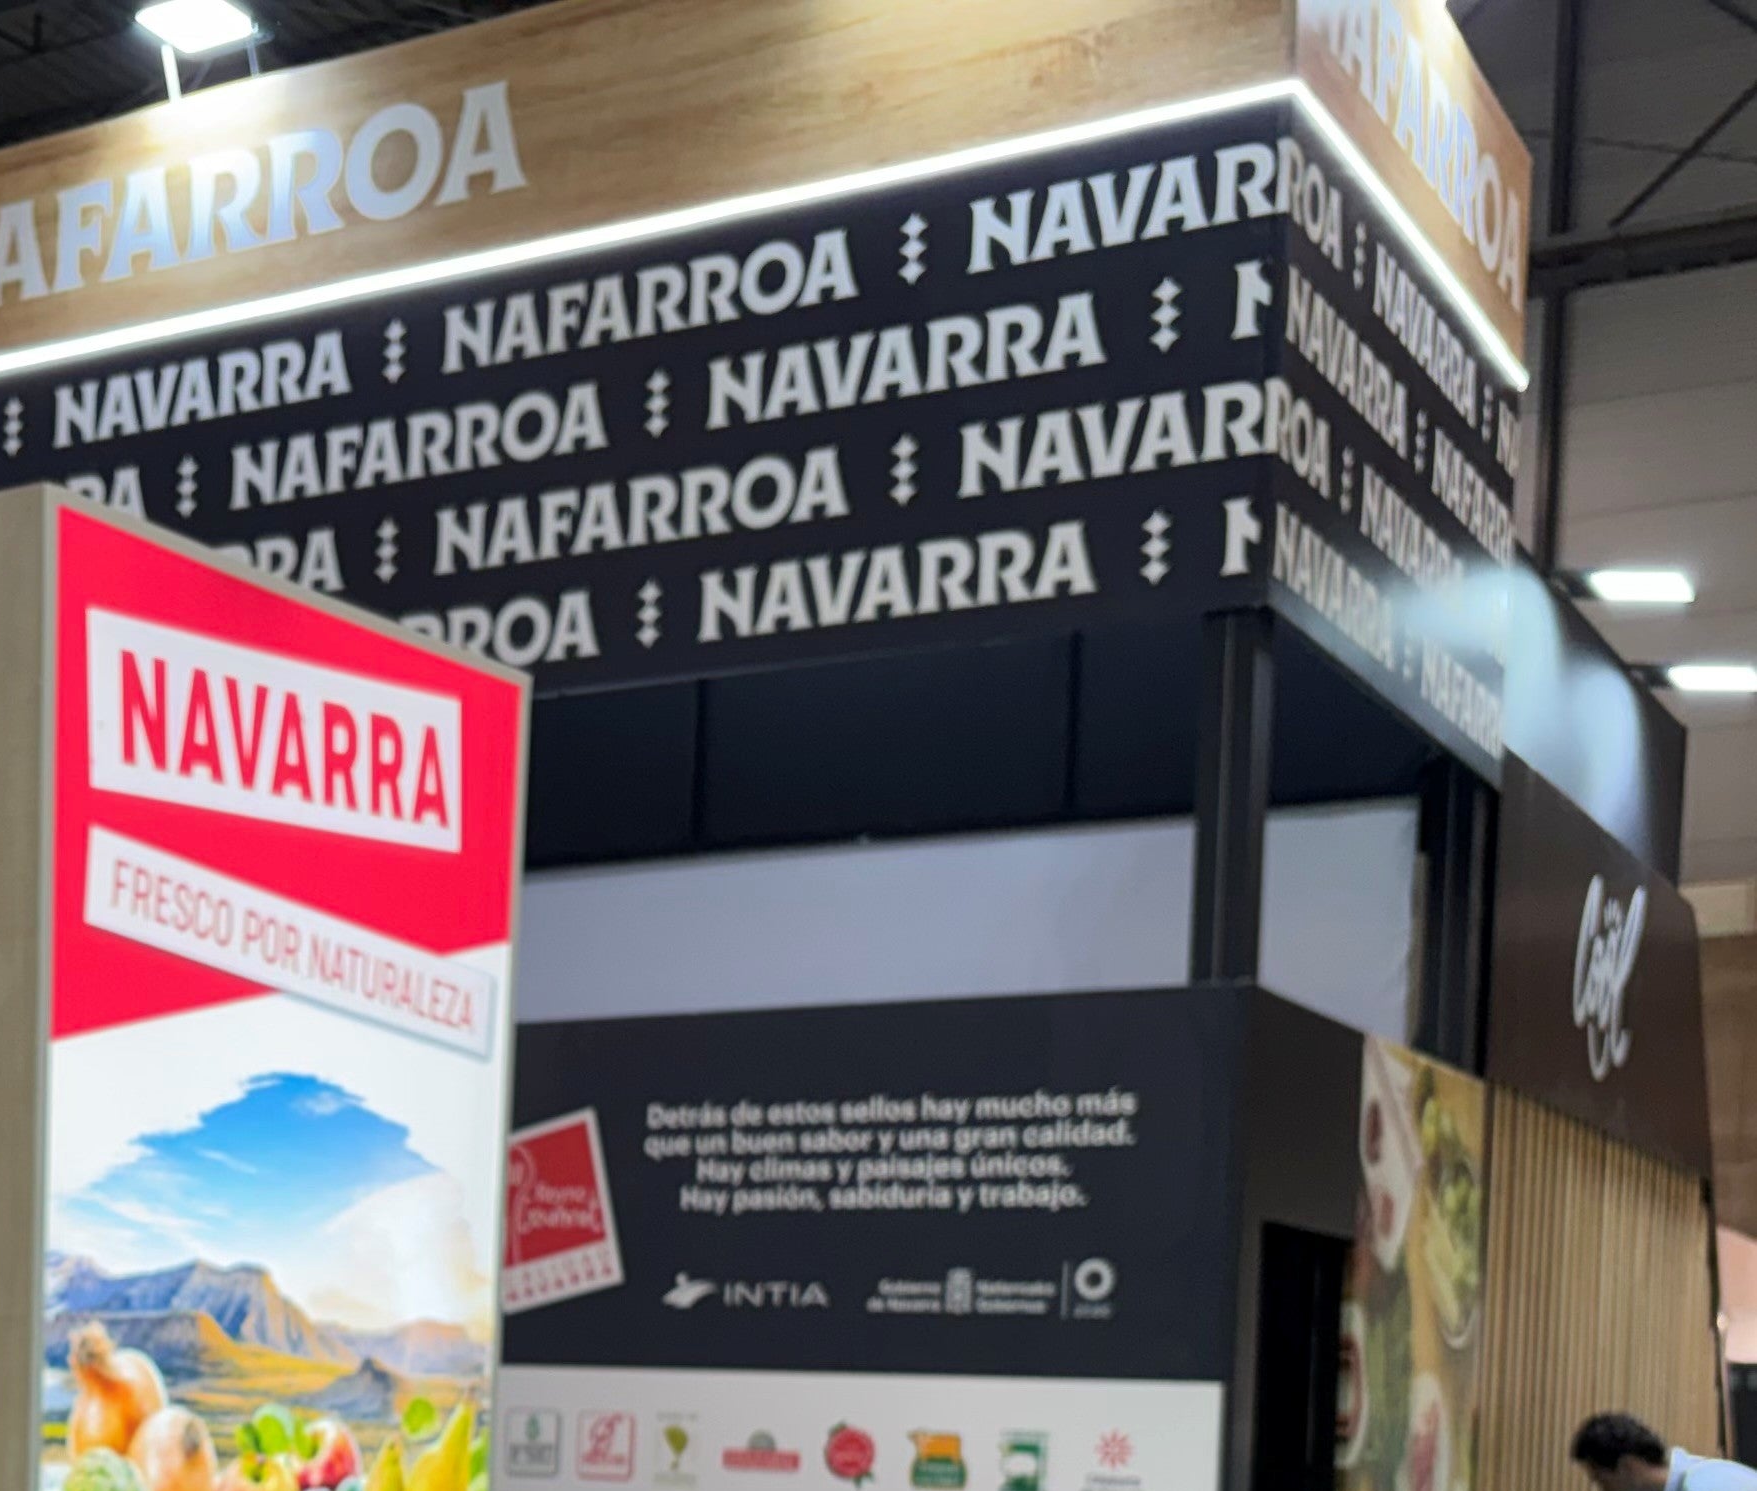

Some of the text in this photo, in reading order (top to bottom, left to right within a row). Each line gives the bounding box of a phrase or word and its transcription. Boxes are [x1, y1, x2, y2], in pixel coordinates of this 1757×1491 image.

[1299, 0, 1524, 313] AFARROA
[52, 330, 352, 449] NAVARRA
[441, 228, 859, 374] NAFARROA
[229, 382, 609, 510] NAFARROA
[705, 292, 1107, 430] NAVARRA
[1286, 265, 1408, 459] NAVARRA
[1373, 243, 1477, 428] NAVARRA
[434, 446, 850, 576] NAFARROA
[697, 521, 1098, 643] NAVARRA
[120, 649, 449, 829] NAVARRA
[112, 858, 476, 1031] FRESCO POR NATURALEZA
[643, 1117, 1137, 1161] que un buen sabor y una gran calidad.
[696, 1159, 746, 1185] Hay
[748, 1156, 834, 1182] climas
[836, 1162, 854, 1185] y
[856, 1155, 966, 1186] paisajes
[730, 1101, 763, 1127] de
[767, 1101, 836, 1127] estos
[840, 1096, 916, 1126] sellos
[920, 1093, 971, 1128] hay
[975, 1089, 1072, 1119] mucho
[1076, 1086, 1137, 1116] más
[680, 1187, 729, 1214] Hay
[957, 1187, 975, 1213] y
[722, 1281, 831, 1308] INTIA
